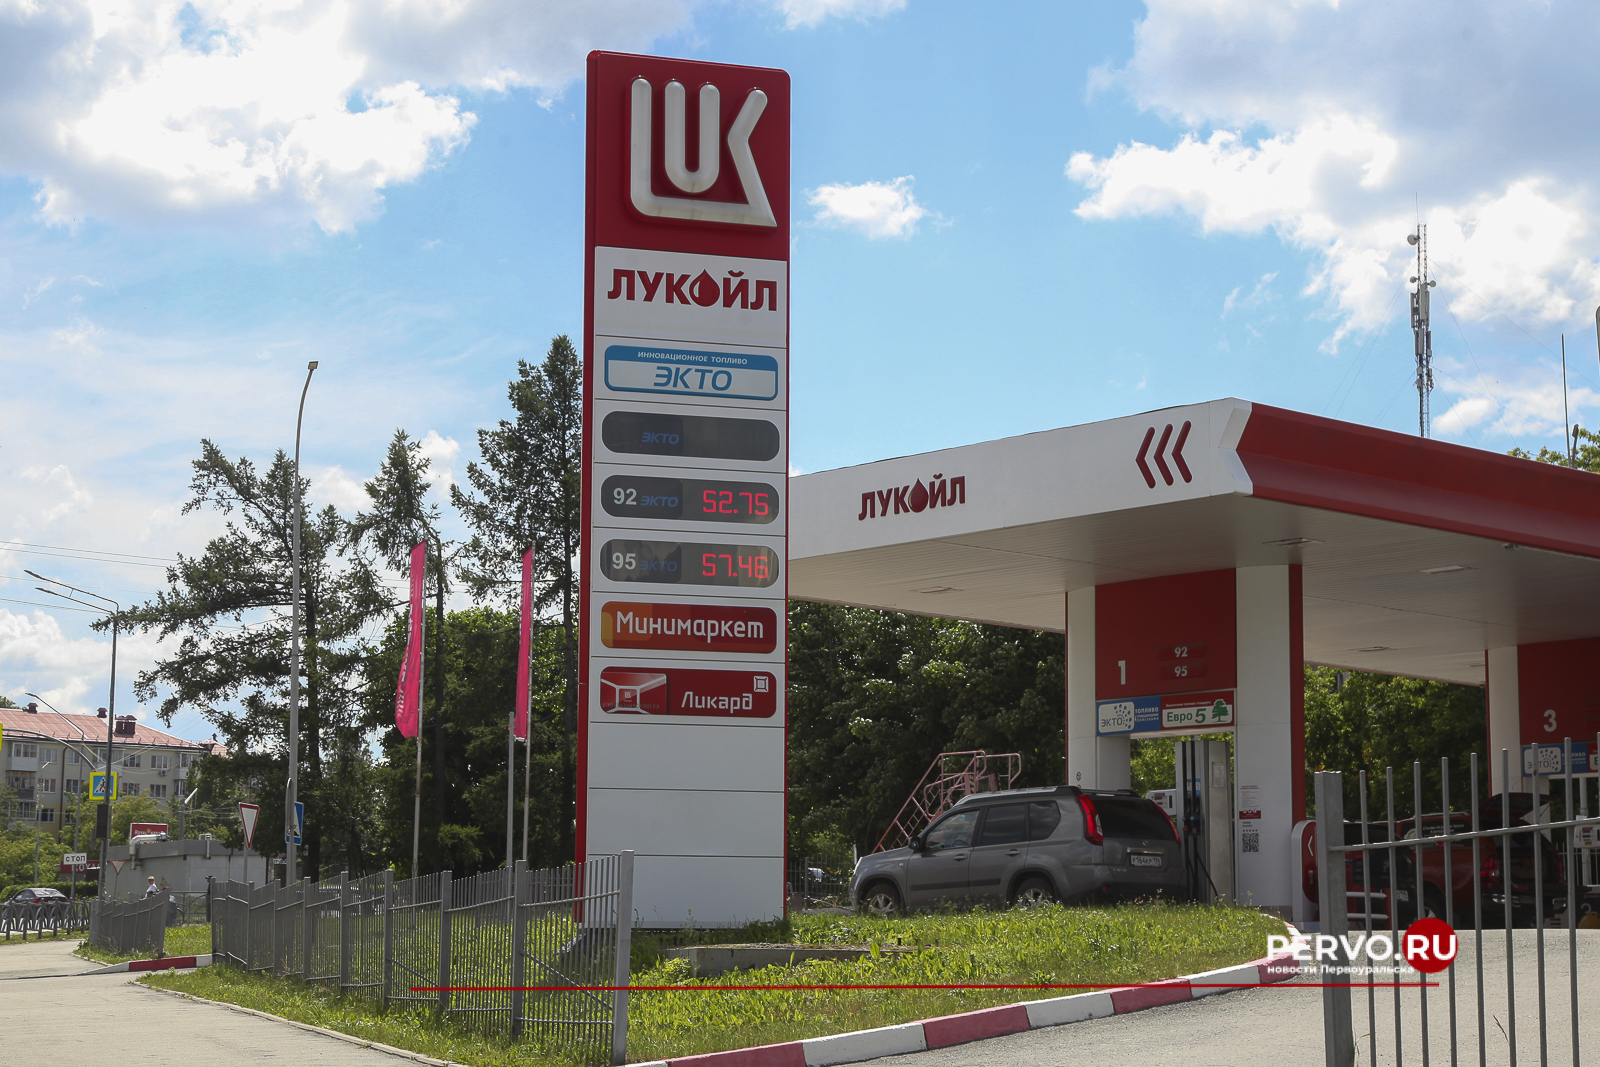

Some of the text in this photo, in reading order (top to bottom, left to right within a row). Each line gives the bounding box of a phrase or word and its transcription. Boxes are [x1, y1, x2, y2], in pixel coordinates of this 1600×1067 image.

[607, 268, 778, 312] ЛУКОЙЛ
[637, 350, 748, 366] ИННОВАЦИОННОЕ ТОПЛИВО
[653, 366, 733, 391] ЭКТО
[641, 432, 680, 444] ЭКТО
[613, 487, 769, 516] 92 ЭКТО 52.75
[858, 472, 966, 521] ЛУКОЙЛ
[612, 552, 768, 579] 95 ЭКТО 57.46
[616, 610, 764, 643] Минимаркет
[1174, 646, 1188, 658] 92
[1117, 660, 1126, 685] 1
[1174, 665, 1188, 677] 95
[681, 690, 753, 714] Ликард
[1101, 717, 1123, 728] ЭКТО
[1167, 711, 1193, 724] Евро
[1194, 708, 1207, 724] 5
[1543, 709, 1557, 732] 3
[1527, 760, 1549, 769] ЭТО
